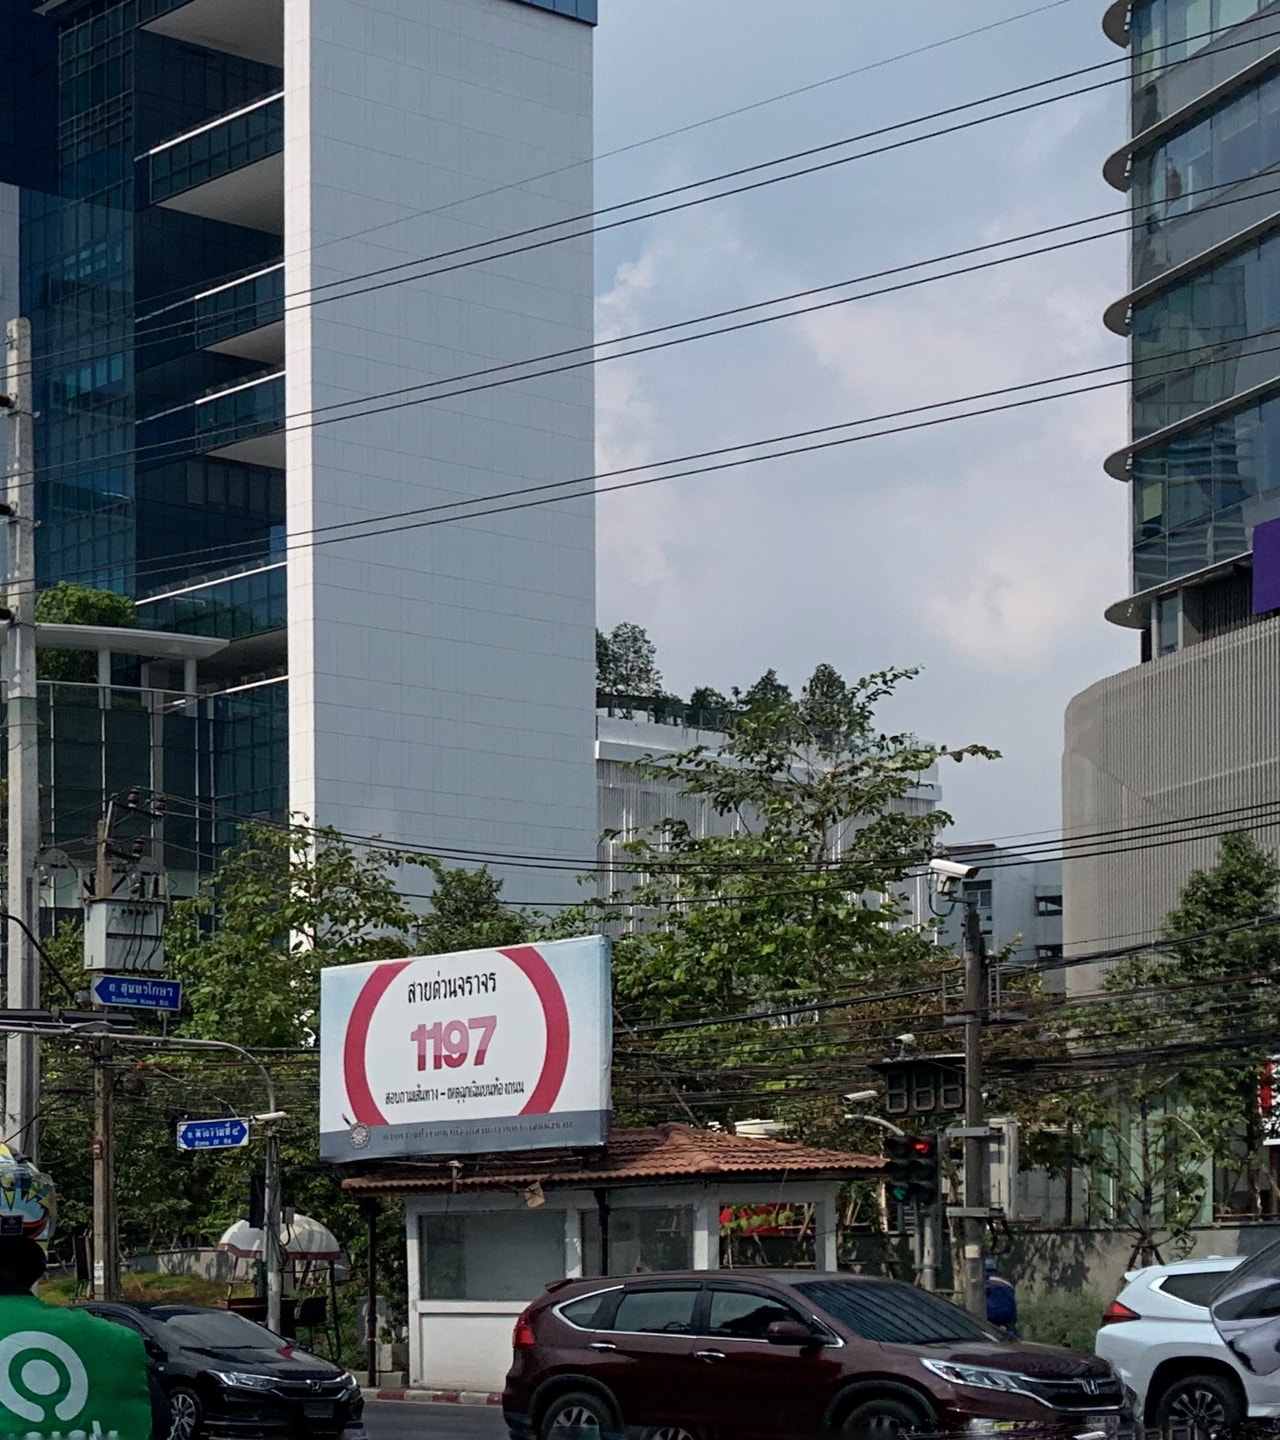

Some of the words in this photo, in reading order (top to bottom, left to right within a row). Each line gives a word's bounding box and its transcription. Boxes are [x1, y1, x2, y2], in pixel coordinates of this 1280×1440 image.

[406, 970, 497, 1004] สายด่วนจราจร
[410, 1015, 498, 1072] 1197
